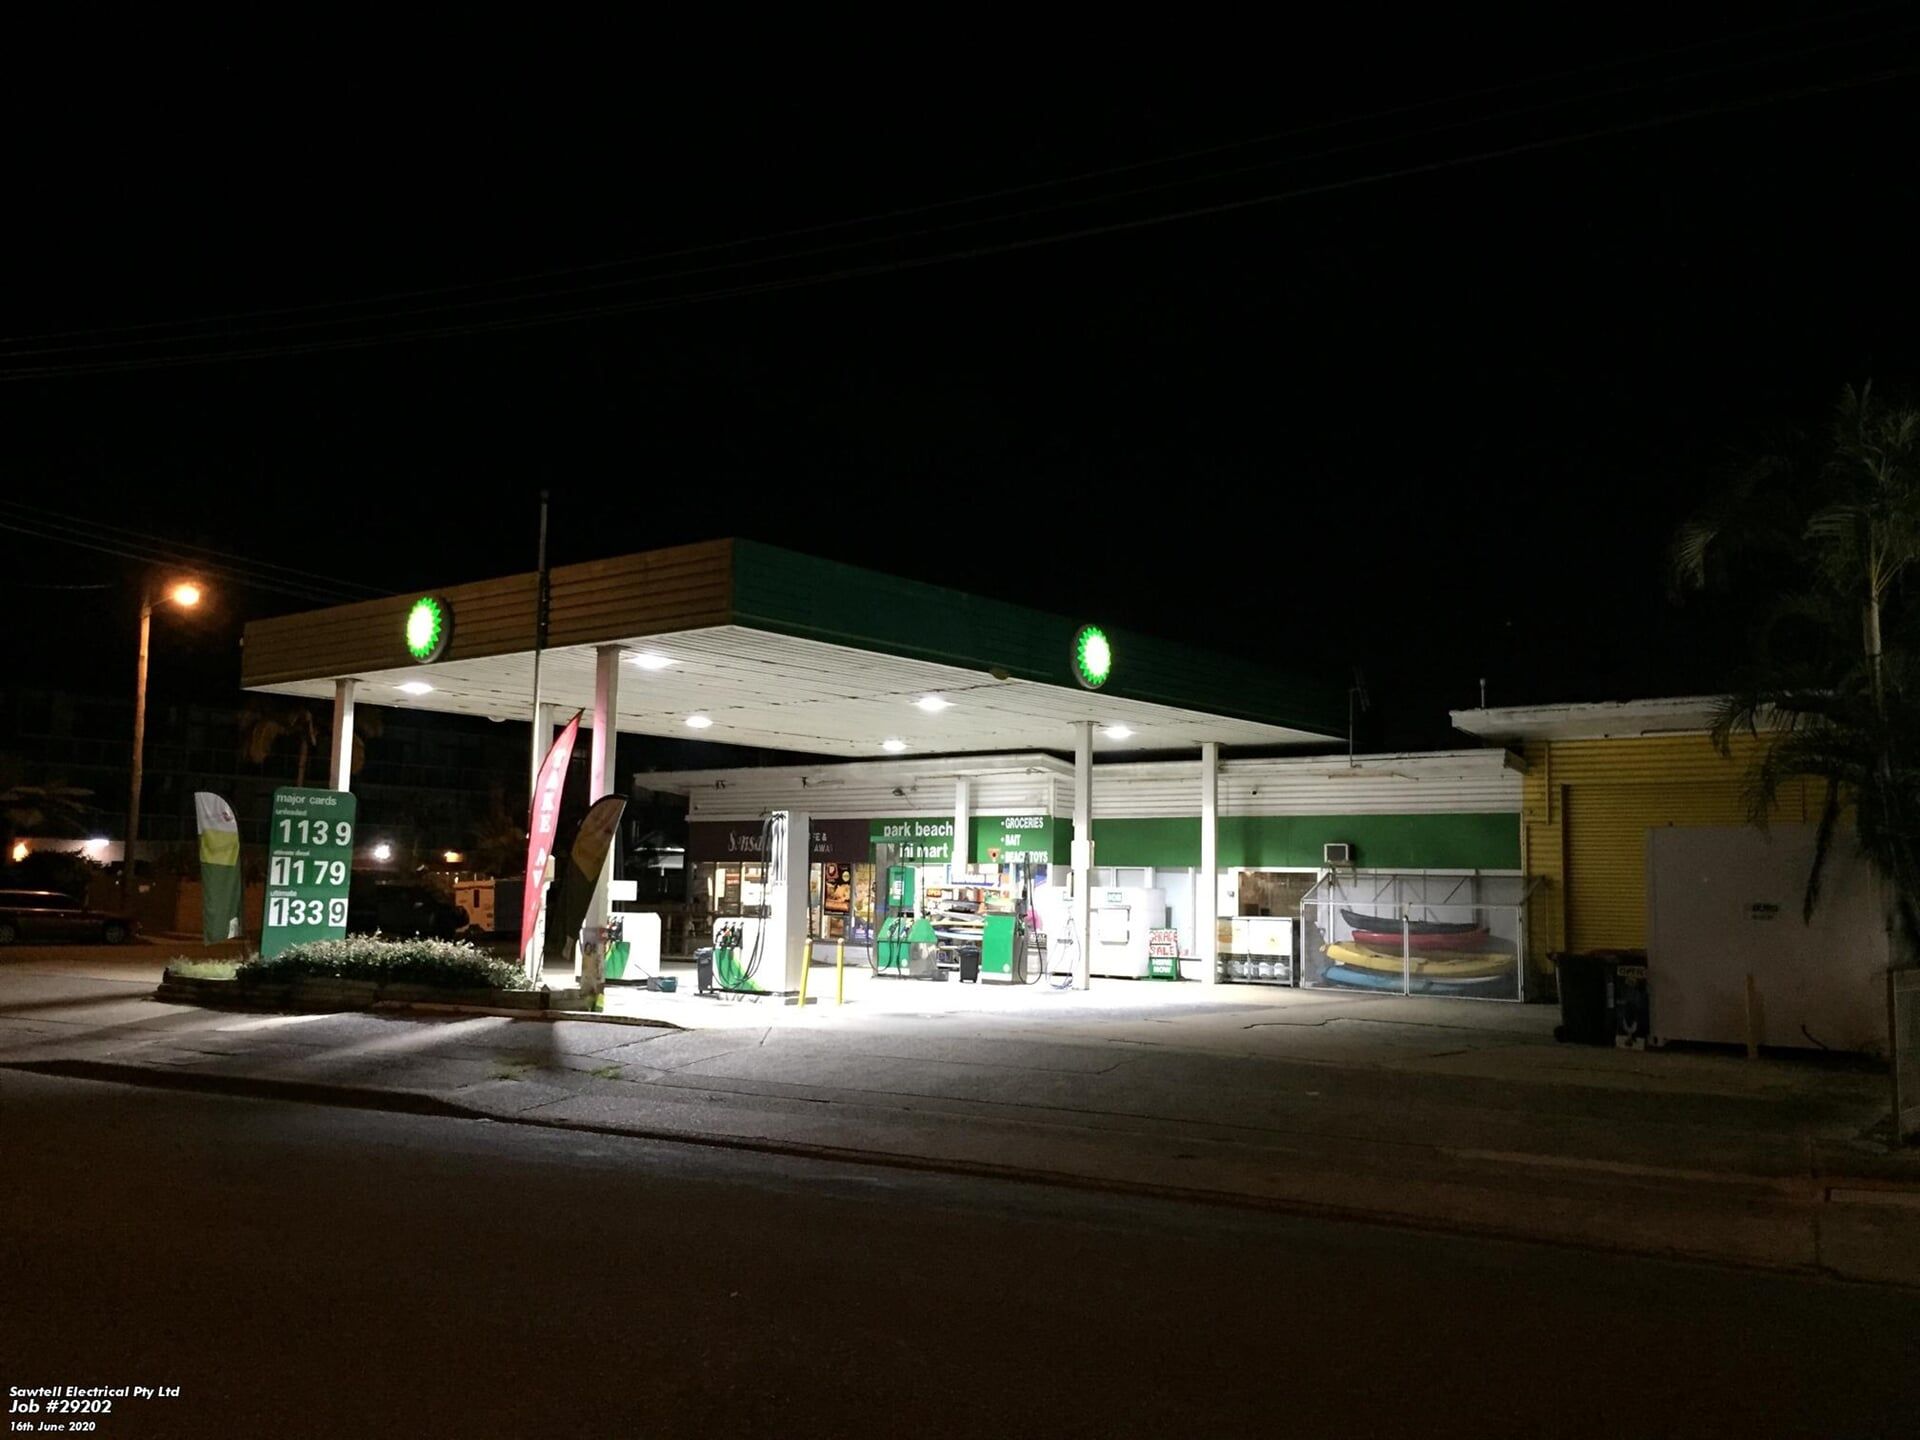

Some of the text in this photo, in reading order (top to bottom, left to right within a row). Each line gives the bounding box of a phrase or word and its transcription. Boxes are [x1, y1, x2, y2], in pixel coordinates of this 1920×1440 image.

[539, 748, 567, 833] TAKE
[276, 794, 337, 806] major cards
[275, 808, 307, 816] unleaded
[1005, 816, 1044, 829] GROCERIES
[884, 821, 954, 837] park beach
[1004, 834, 1021, 846] BAIT
[917, 842, 949, 858] mart
[1029, 851, 1049, 863] TOYS
[270, 889, 298, 897] ultimate
[1149, 946, 1175, 956] SALE
